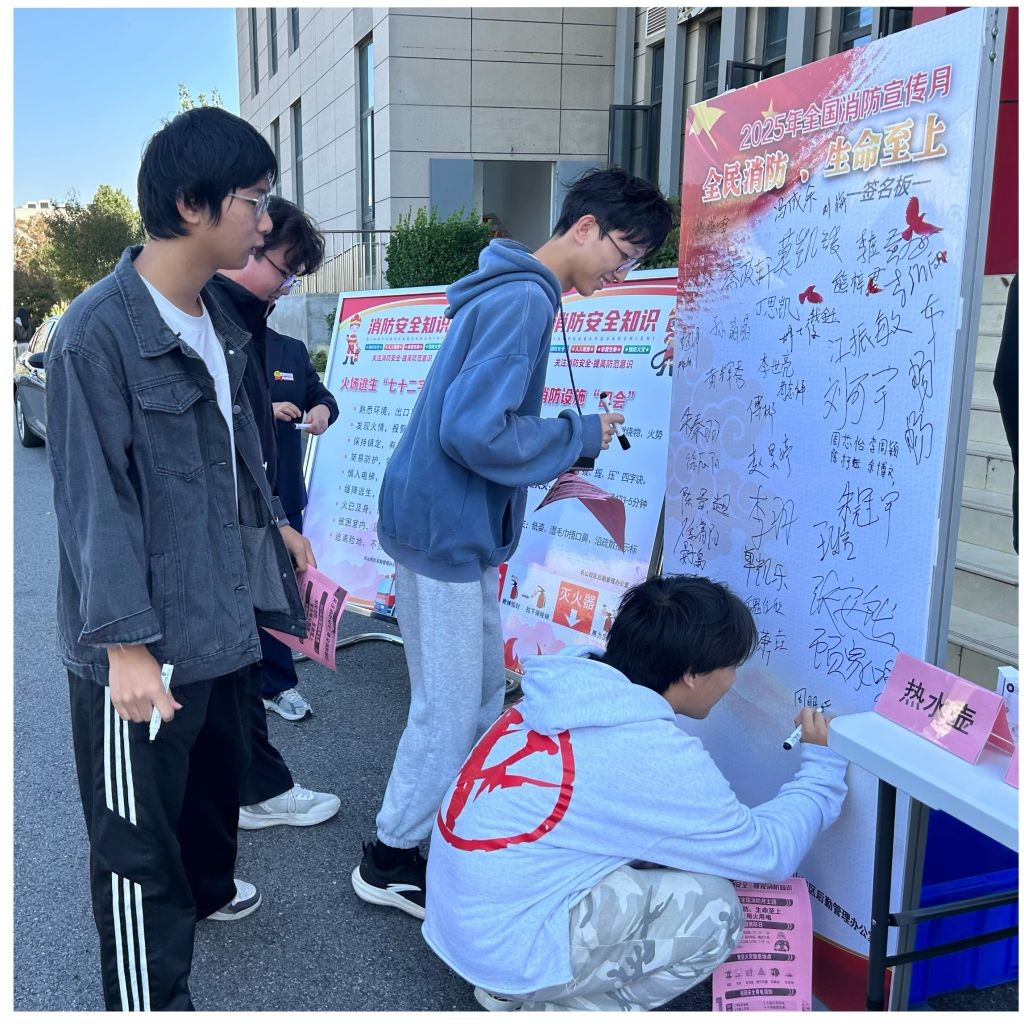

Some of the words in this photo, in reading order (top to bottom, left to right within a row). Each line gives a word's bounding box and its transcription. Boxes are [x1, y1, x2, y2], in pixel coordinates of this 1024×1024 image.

[739, 63, 952, 151] 2025年全国消防宣传月
[701, 112, 948, 203] 全民消防、生命至上
[367, 315, 450, 335] 消防安全知识
[340, 377, 379, 393] 火场逃生
[358, 405, 412, 417] 熟悉环境，出口
[350, 452, 390, 466] 简易防护，
[559, 586, 596, 611] 灭火器
[898, 678, 977, 736] 热水壶
